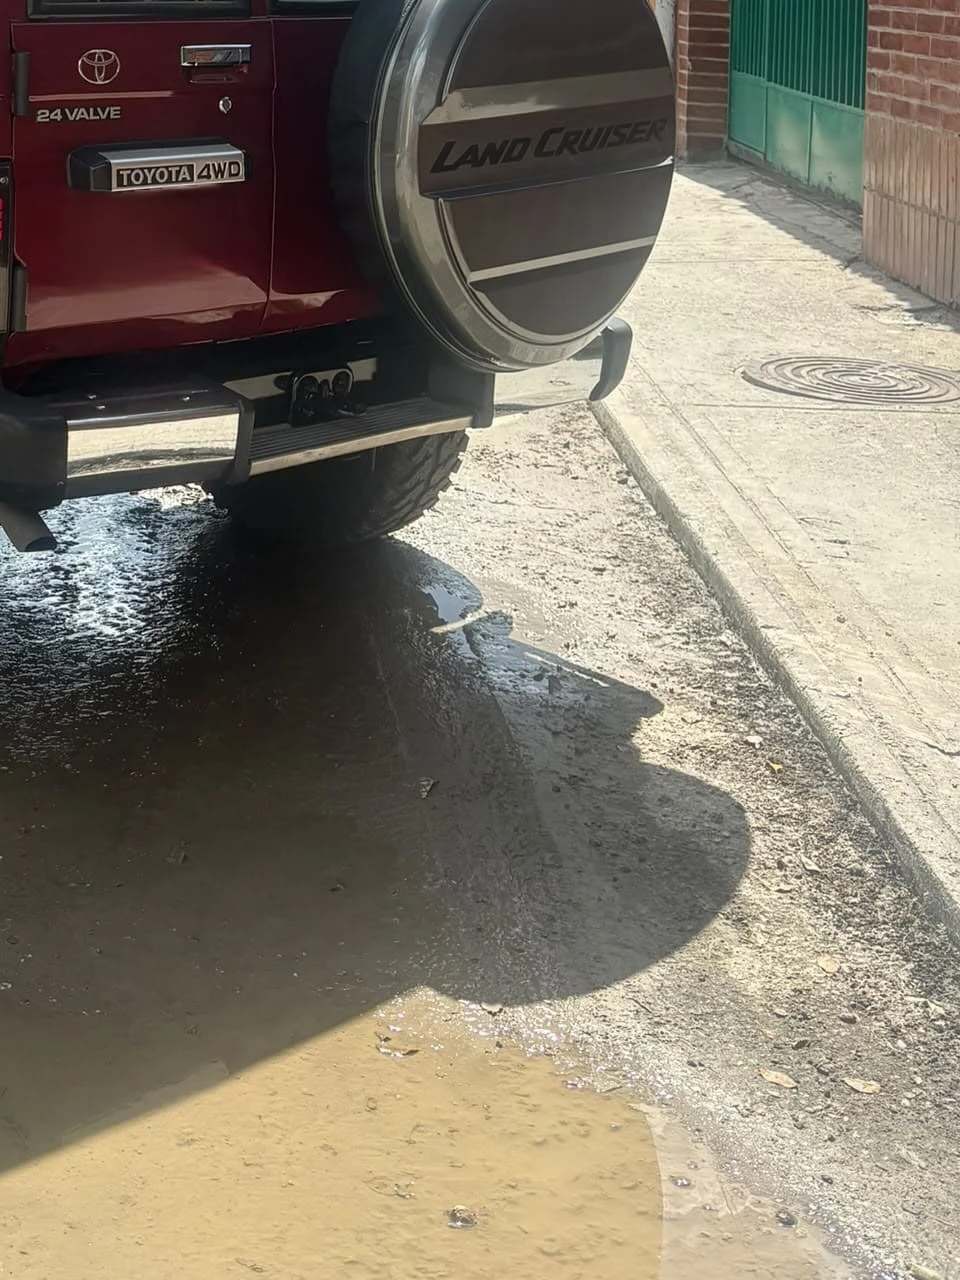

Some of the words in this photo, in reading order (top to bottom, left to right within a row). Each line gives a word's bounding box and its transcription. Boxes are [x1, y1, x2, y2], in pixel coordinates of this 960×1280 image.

[37, 108, 62, 122] 24
[64, 106, 121, 121] VALVE
[430, 136, 531, 174] LAND
[533, 118, 669, 158] CRUISER
[119, 165, 191, 187] TOYOTA
[197, 161, 242, 180] 4WD
